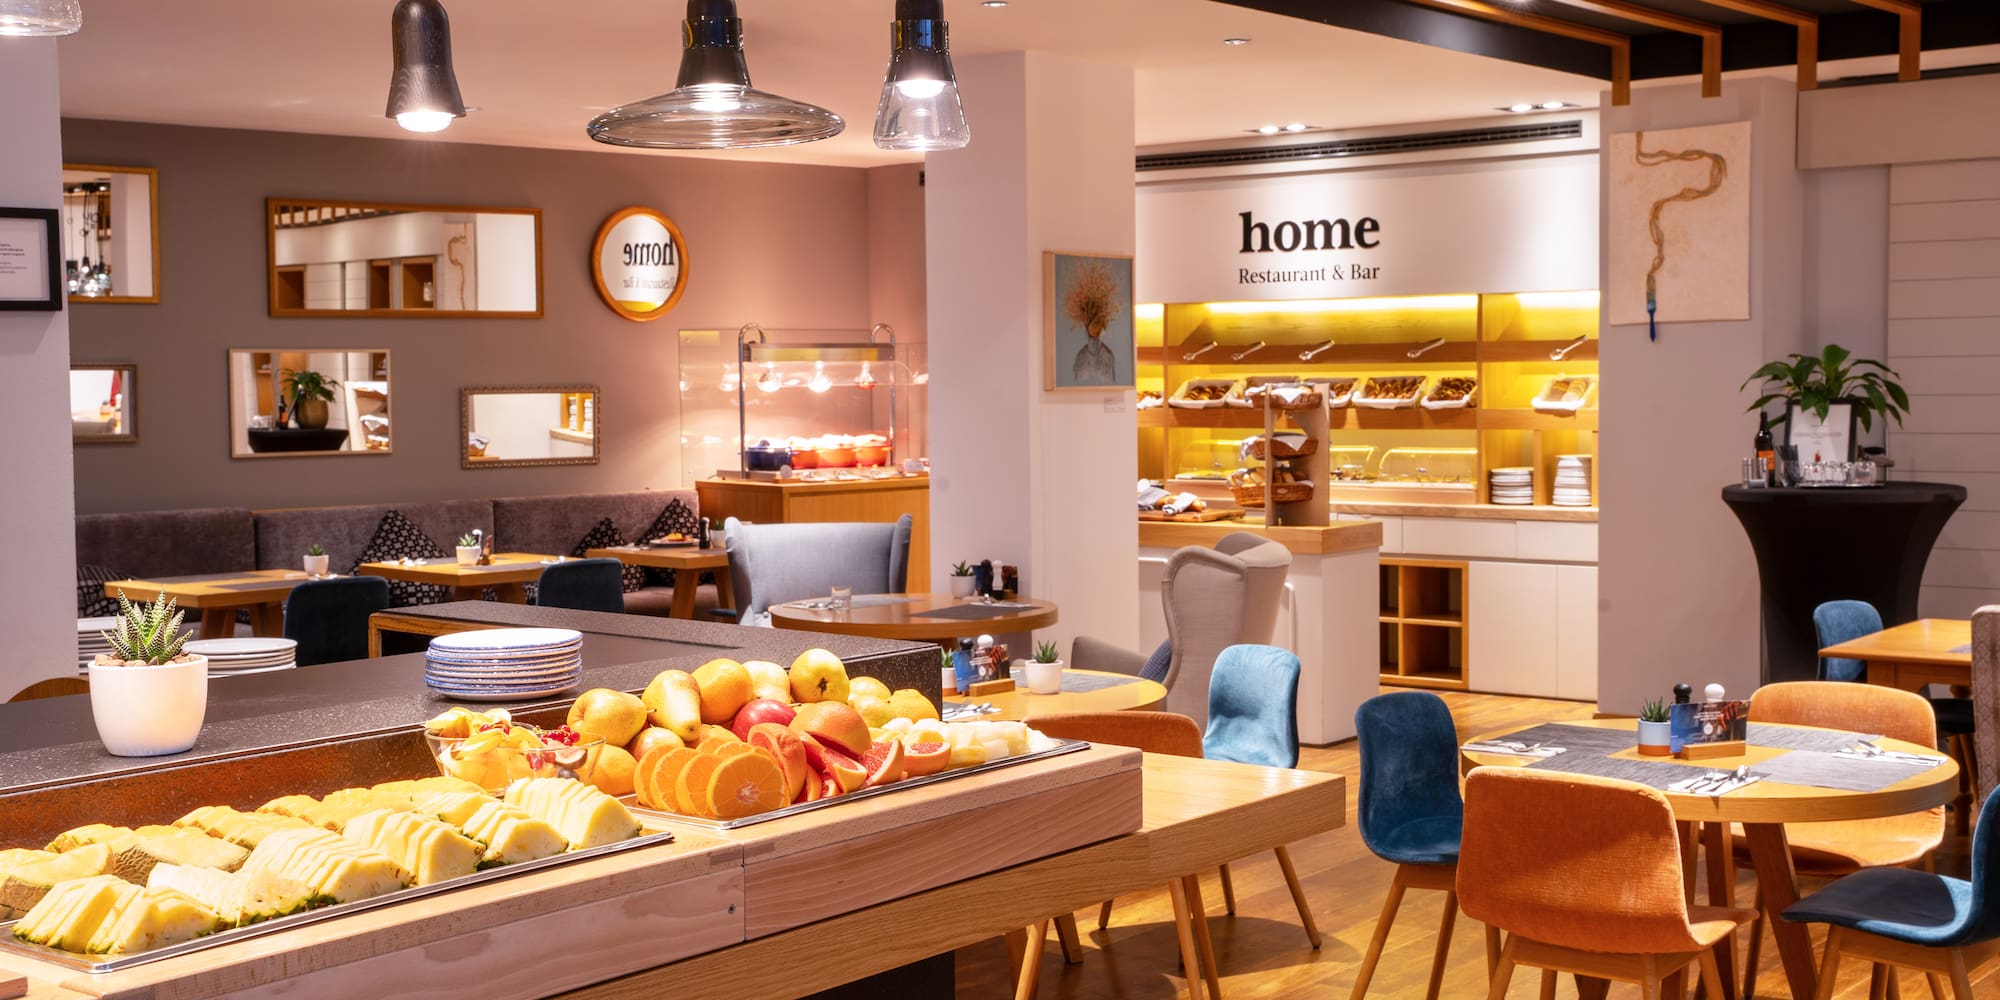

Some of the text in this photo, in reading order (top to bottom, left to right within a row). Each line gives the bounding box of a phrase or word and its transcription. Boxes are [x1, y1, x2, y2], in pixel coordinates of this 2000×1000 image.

[1239, 211, 1380, 253] home
[1239, 264, 1380, 285] Restaurant & Bar
